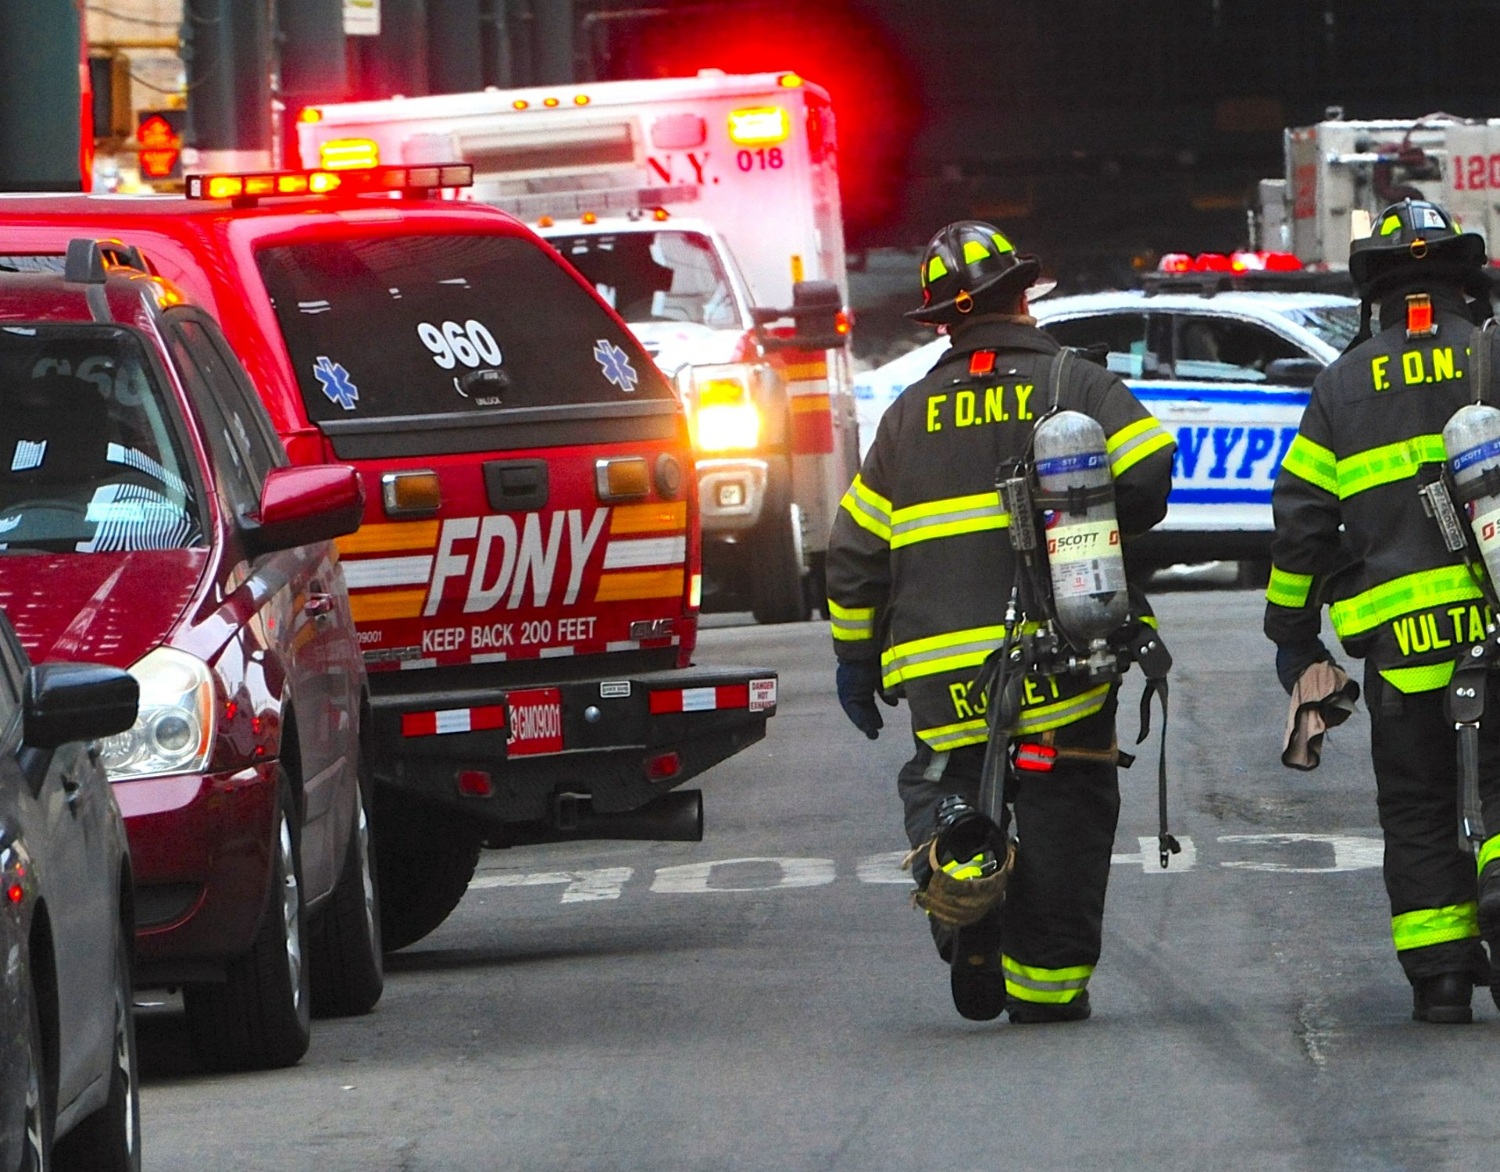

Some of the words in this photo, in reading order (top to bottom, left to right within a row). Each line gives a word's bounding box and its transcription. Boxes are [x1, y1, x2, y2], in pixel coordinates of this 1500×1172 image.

[737, 147, 784, 172] 018
[417, 319, 502, 369] 960
[1371, 347, 1472, 391] F.D.N.
[1057, 532, 1100, 549] SCOTT
[423, 507, 609, 617] FDNY
[422, 627, 465, 652] KEEP
[470, 624, 514, 649] BACK
[521, 620, 552, 645] 200
[557, 617, 597, 642] FEET
